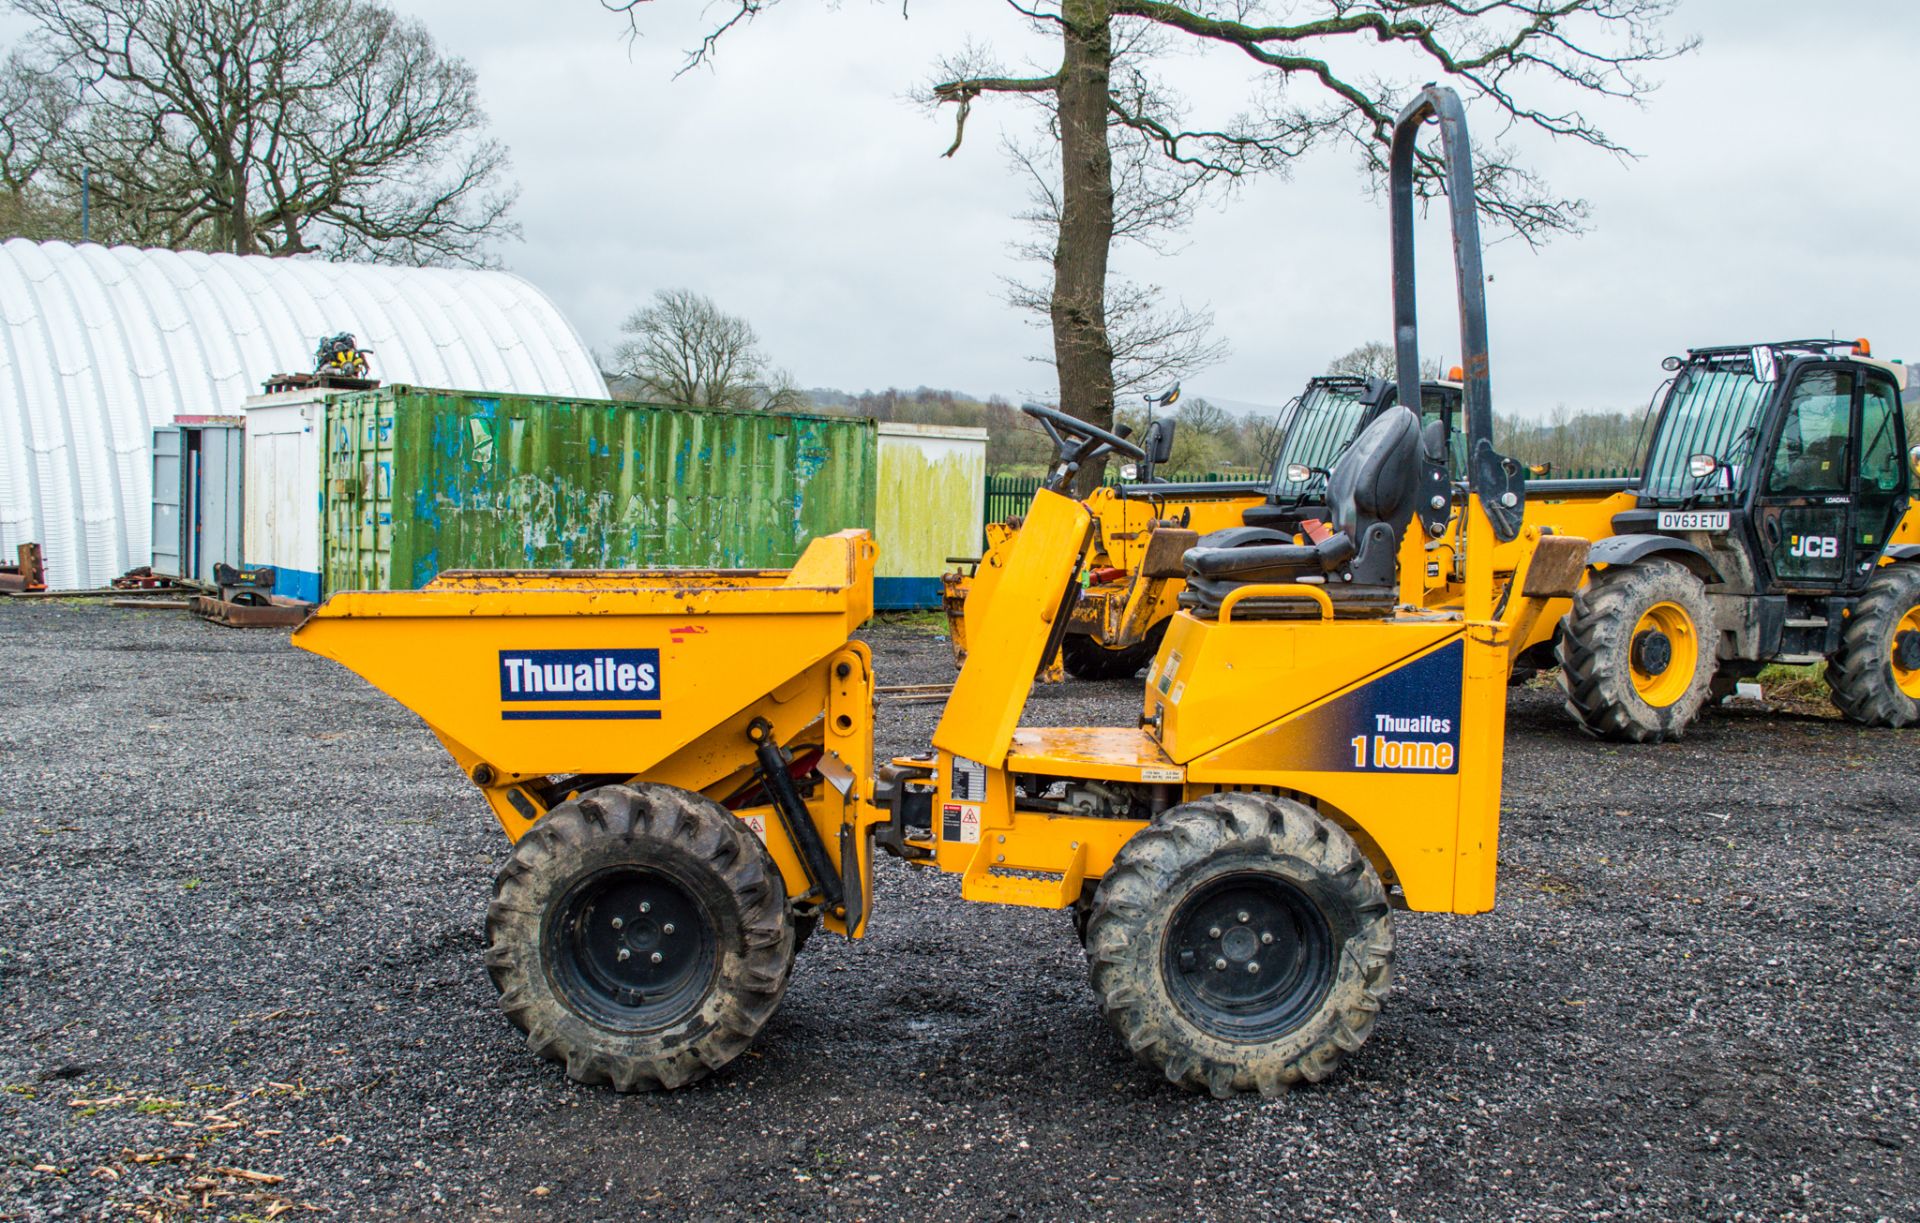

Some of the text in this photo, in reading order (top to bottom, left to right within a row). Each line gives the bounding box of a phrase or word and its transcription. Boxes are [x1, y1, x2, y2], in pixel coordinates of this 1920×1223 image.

[1663, 513, 1724, 528] OV63 ETU
[1790, 535, 1838, 558] JCB
[504, 657, 656, 692] Thwaites
[1375, 714, 1451, 733] Thwaites
[1351, 735, 1454, 770] 1 tonne
